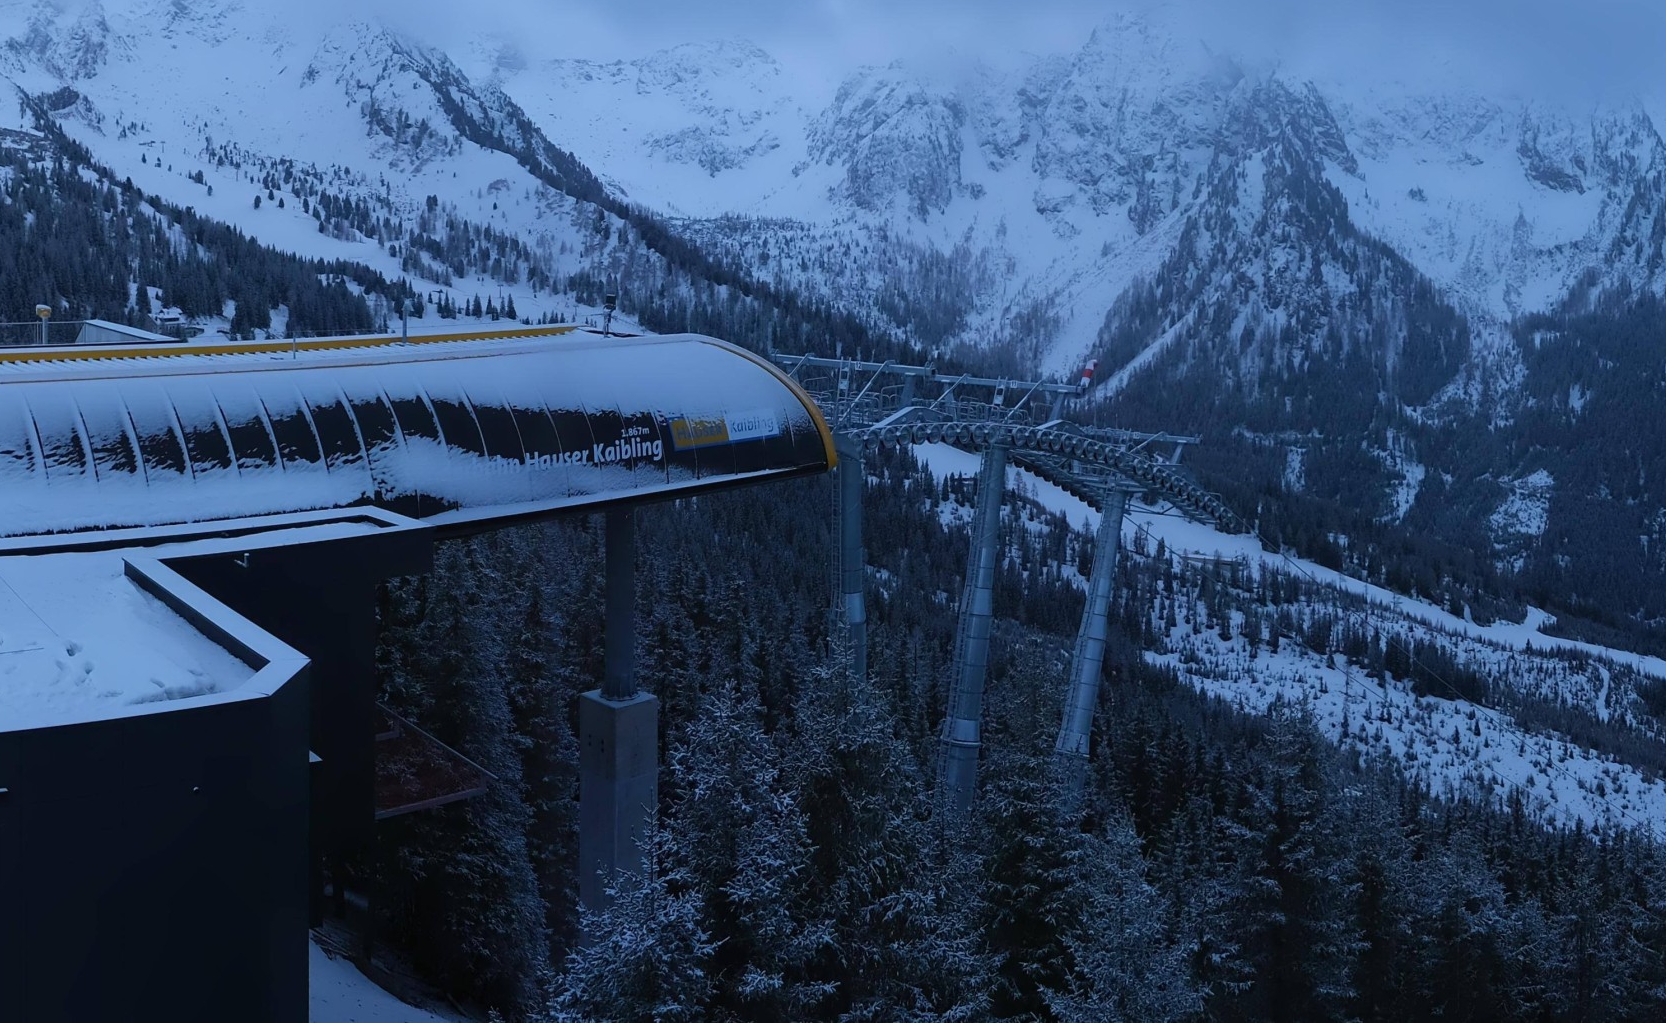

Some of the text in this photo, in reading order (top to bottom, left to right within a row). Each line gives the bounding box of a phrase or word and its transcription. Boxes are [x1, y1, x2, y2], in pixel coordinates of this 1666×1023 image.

[620, 426, 650, 438] 1.867m
[730, 417, 775, 433] Kaibling
[524, 449, 590, 471] Hauser
[592, 437, 664, 463] Kaibling
